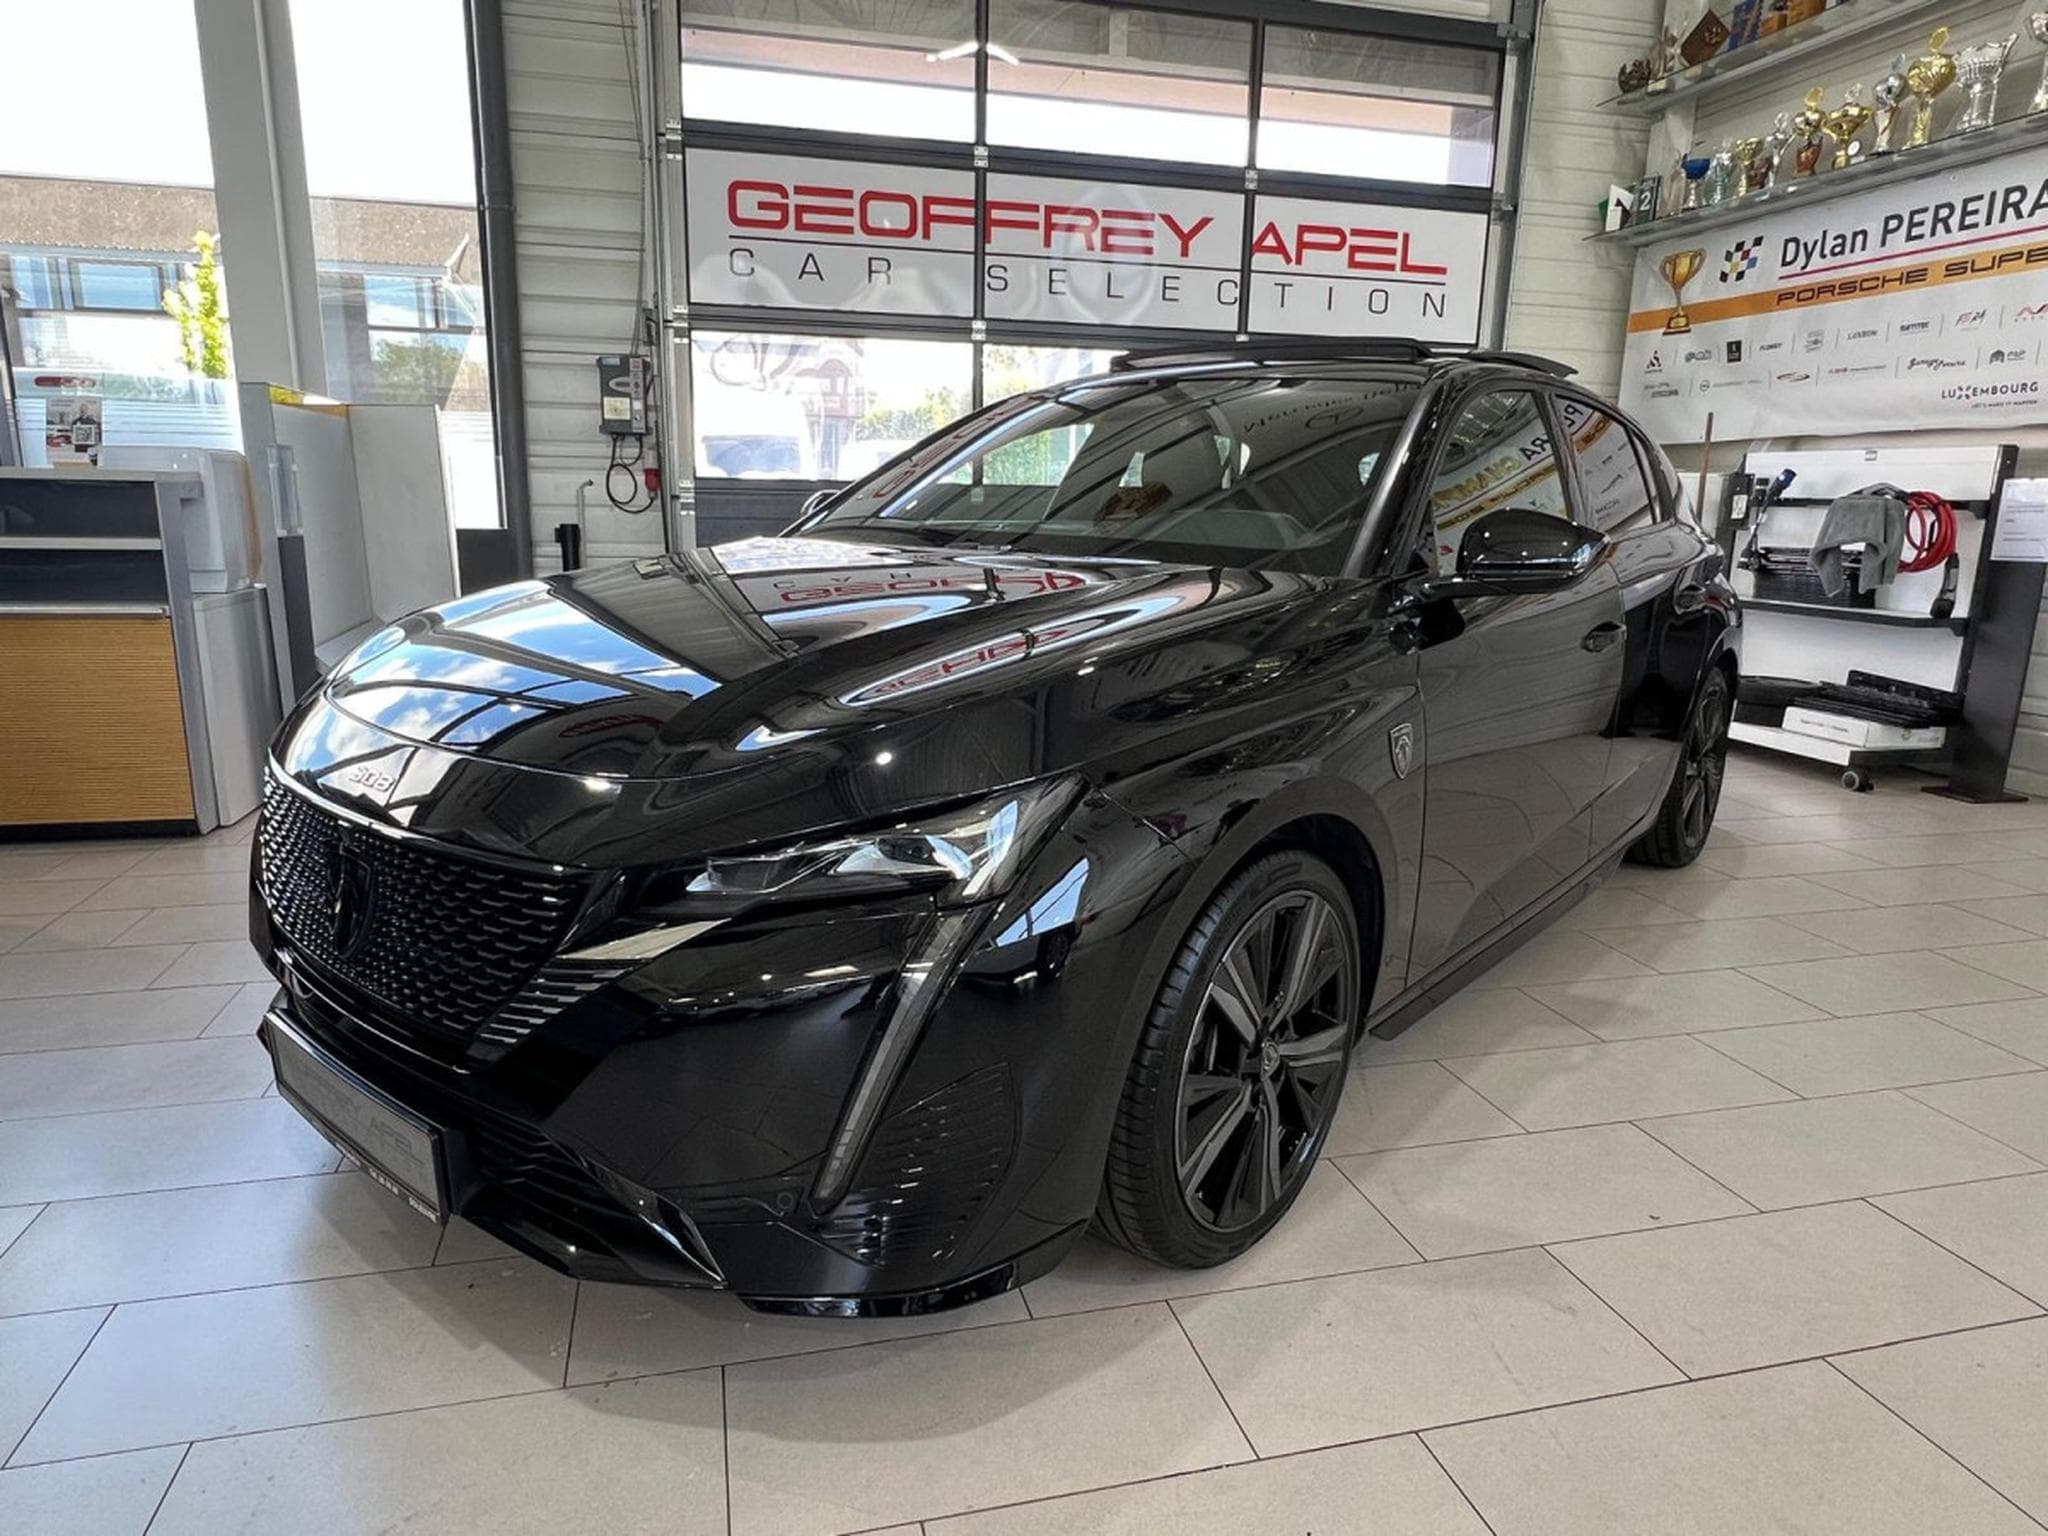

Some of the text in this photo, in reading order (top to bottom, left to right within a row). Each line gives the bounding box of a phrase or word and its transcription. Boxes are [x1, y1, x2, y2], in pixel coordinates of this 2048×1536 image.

[728, 180, 1448, 275] GEOFFREY APEL
[1780, 178, 2048, 271] Dylan PEREIRA
[729, 248, 1446, 318] CAR SELECTION
[1776, 266, 1929, 306] PORSCHE
[1941, 381, 2039, 400] LUXEMBOURG
